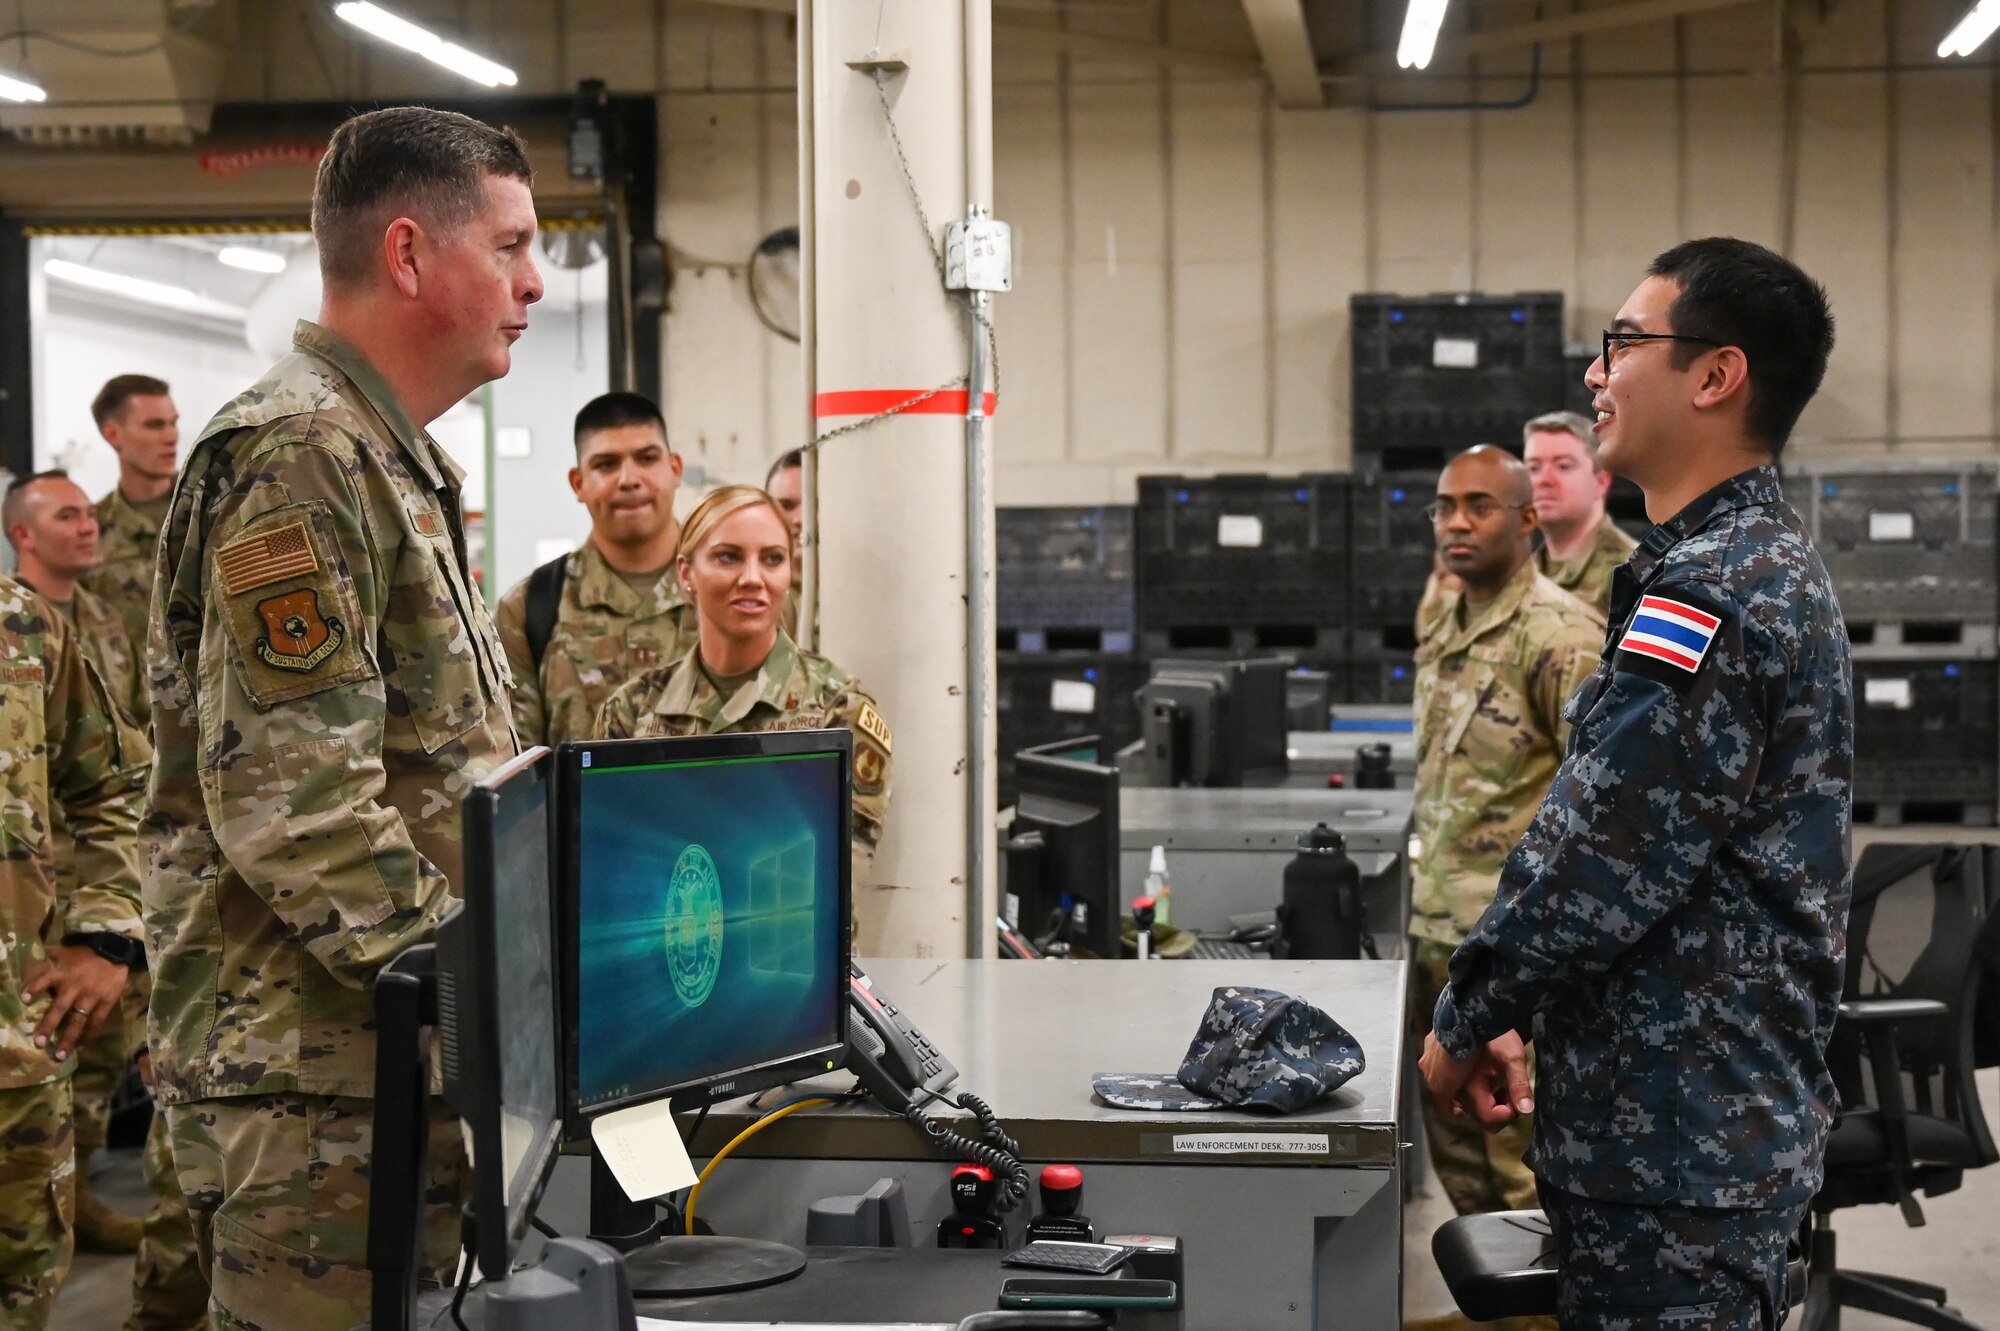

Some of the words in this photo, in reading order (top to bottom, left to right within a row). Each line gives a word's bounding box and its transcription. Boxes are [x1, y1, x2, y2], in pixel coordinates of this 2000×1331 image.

[274, 653, 321, 668] SUSTAINMENT
[768, 720, 787, 732] AIR
[789, 715, 823, 729] FORCE
[863, 710, 890, 742] SUP
[1176, 1141, 1195, 1150] LAW
[1197, 1141, 1259, 1151] ENFORCEMENT
[1261, 1142, 1285, 1151] DESK:
[1288, 1142, 1327, 1151] 777-3058
